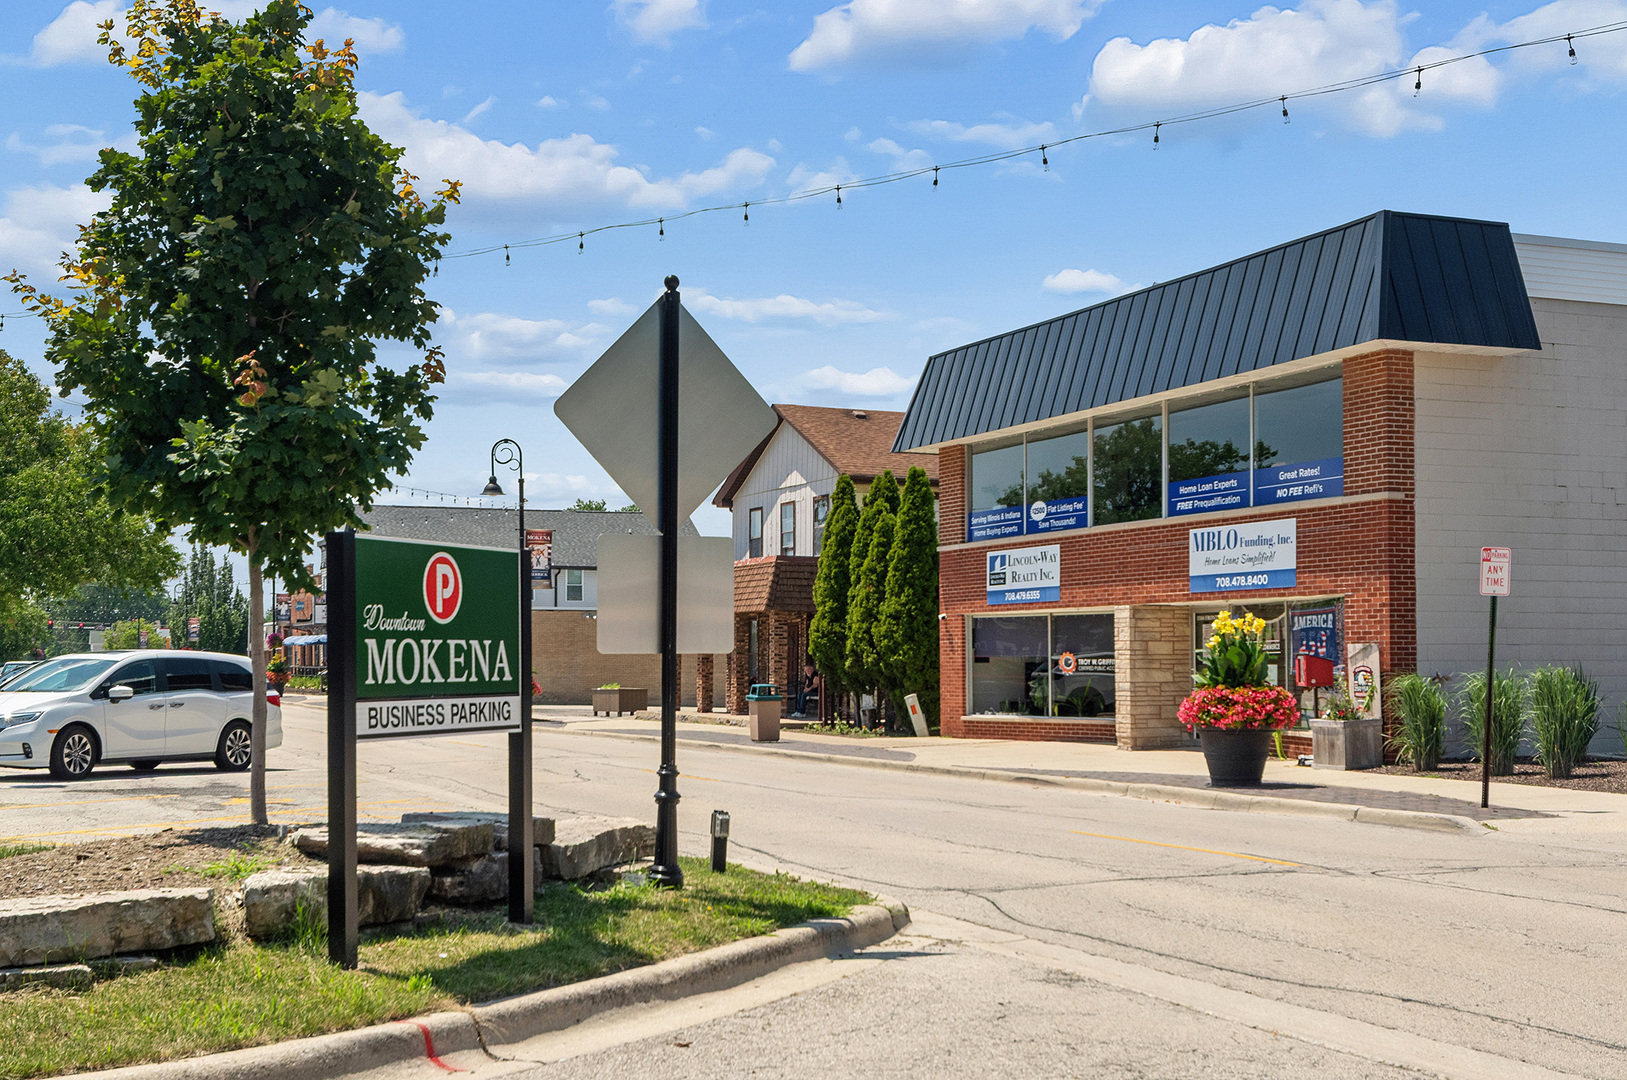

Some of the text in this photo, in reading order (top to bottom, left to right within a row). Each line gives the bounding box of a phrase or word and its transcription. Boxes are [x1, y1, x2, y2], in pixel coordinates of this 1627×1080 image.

[1279, 466, 1321, 480] Great Rates!
[1179, 478, 1238, 494] Home Loan Experts
[1276, 484, 1323, 498] NO FEE Refi's
[1047, 505, 1057, 513] Flat
[1057, 503, 1073, 512] Listing
[1176, 494, 1241, 511] FREE Prequalification
[971, 511, 1021, 525] Serving Illinois & Indiana
[1038, 516, 1076, 529] Save Thousands!
[986, 528, 1001, 537] Buying
[1001, 526, 1018, 534] Experts
[1193, 528, 1238, 553] MBLO
[1277, 534, 1293, 545] Inc.
[1204, 551, 1277, 568] Home Loans Simplified!
[1487, 565, 1503, 574] ANY
[1011, 571, 1038, 583] REALTY
[1216, 574, 1269, 588] 708.478.8400
[1486, 577, 1504, 587] TIME
[436, 563, 456, 613] P
[363, 604, 426, 632] Downtown
[1292, 613, 1334, 631] AMERICA
[364, 638, 513, 685] MOKENA
[368, 701, 512, 730] BUSINESS PARKING
